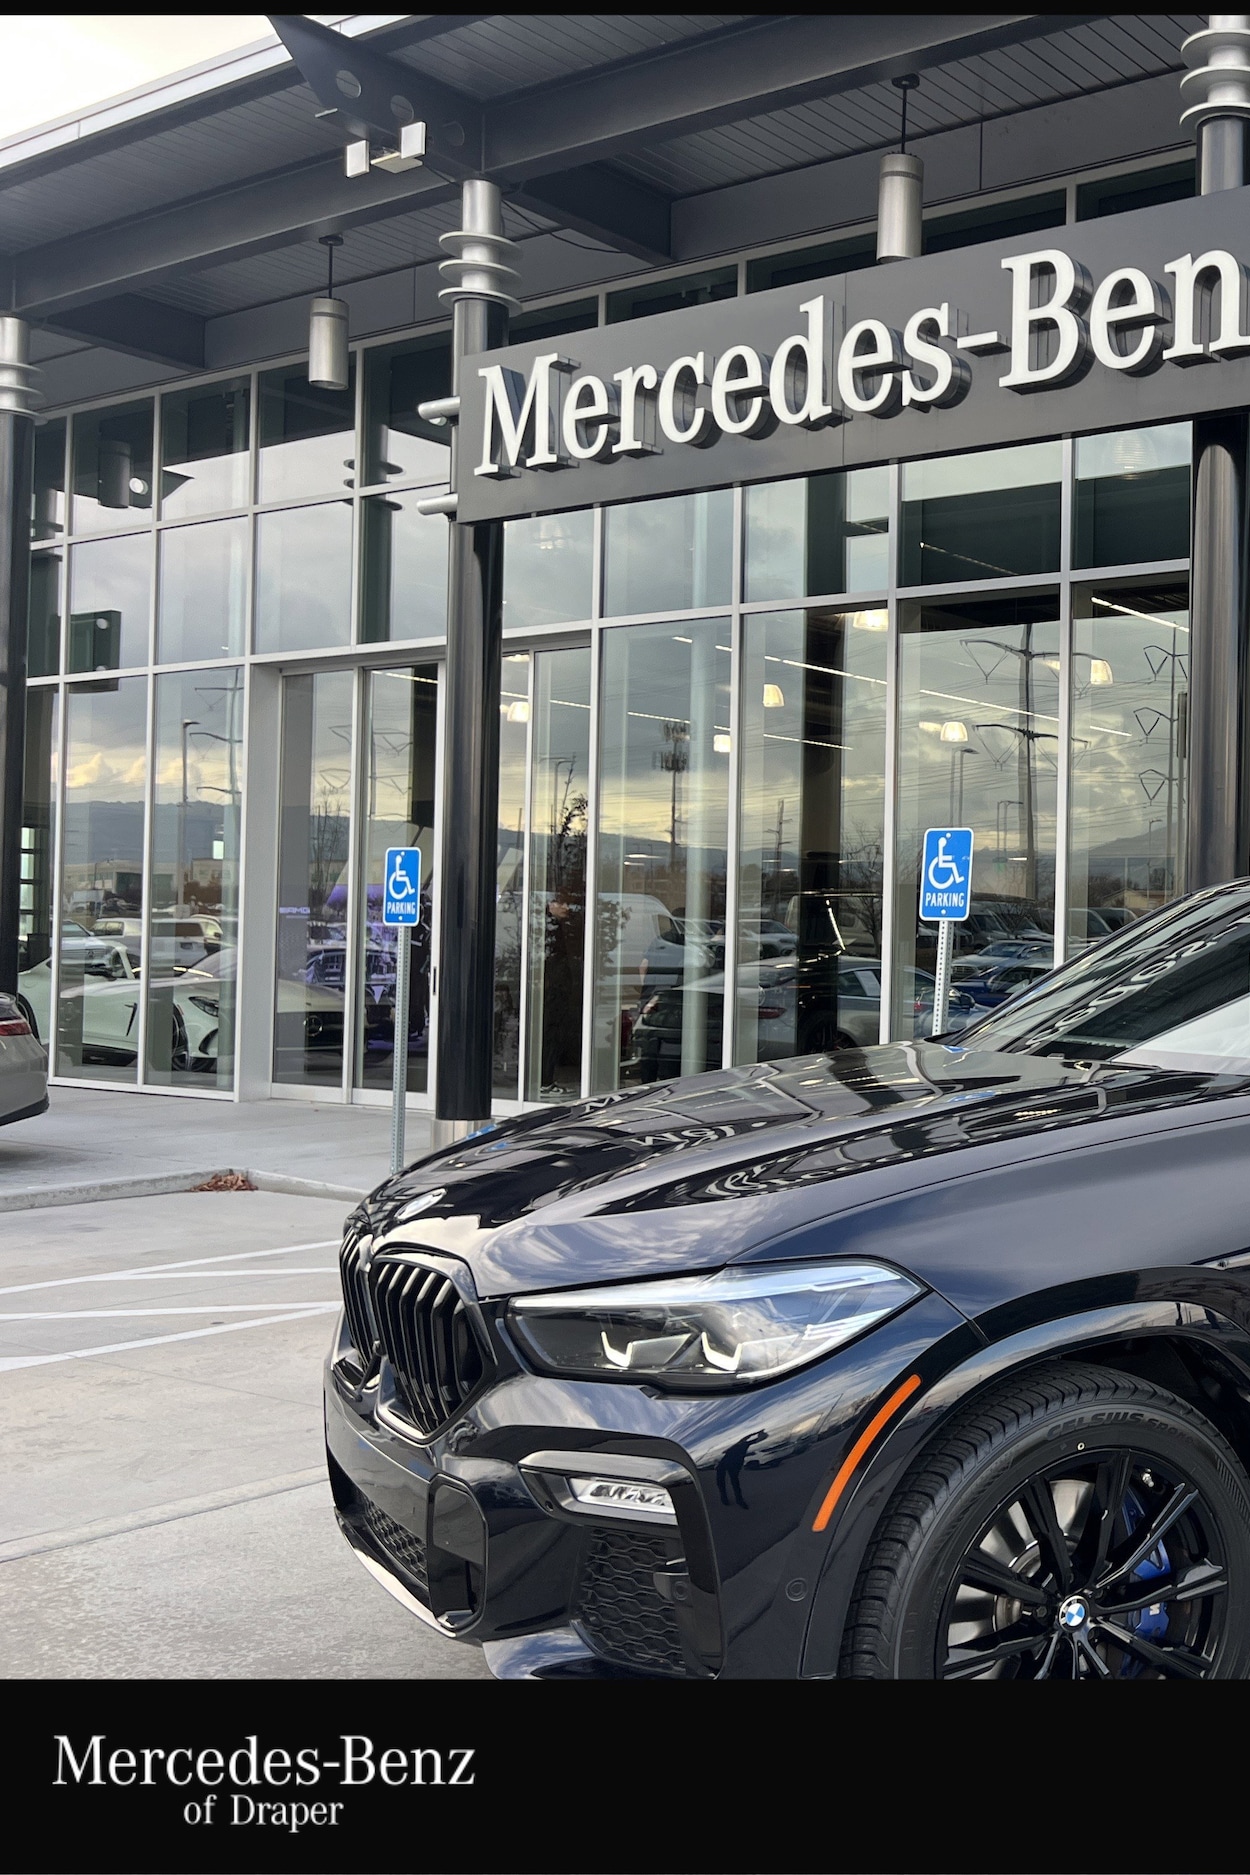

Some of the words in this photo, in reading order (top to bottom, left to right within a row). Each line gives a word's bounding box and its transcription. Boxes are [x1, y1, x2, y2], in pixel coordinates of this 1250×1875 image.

[386, 901, 416, 915] PARKING
[924, 892, 965, 908] PARKING
[1046, 1411, 1144, 1440] CELSIUS
